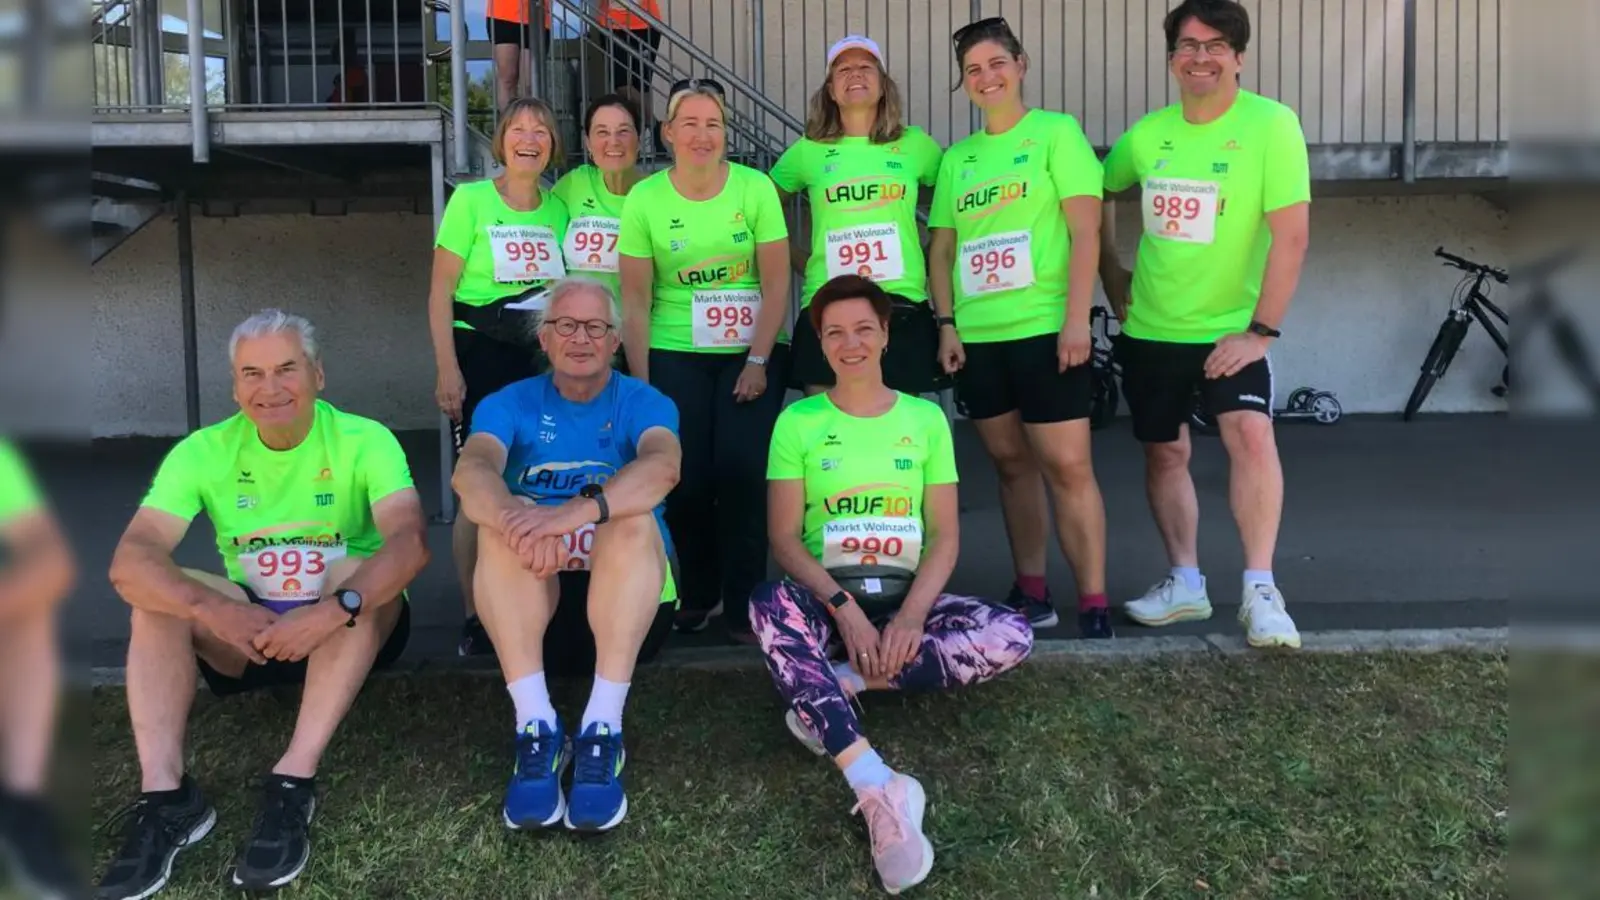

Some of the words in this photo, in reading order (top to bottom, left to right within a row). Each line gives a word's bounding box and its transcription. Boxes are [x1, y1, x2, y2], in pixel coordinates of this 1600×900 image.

[825, 183, 906, 204] LAUF10!
[956, 181, 1027, 213] LAUF10!
[1153, 194, 1201, 220] 989
[505, 241, 550, 262] 995
[574, 231, 619, 252] 997
[838, 240, 888, 267] 991
[970, 247, 1016, 276] 996
[677, 259, 750, 286] LAUF10!
[694, 293, 722, 303] Markt
[706, 306, 753, 328] 998
[824, 496, 913, 518] LAUF10!
[826, 522, 861, 533] Markt
[862, 522, 917, 533] Wolnzach
[841, 536, 903, 557] 990
[257, 549, 326, 578] 993
